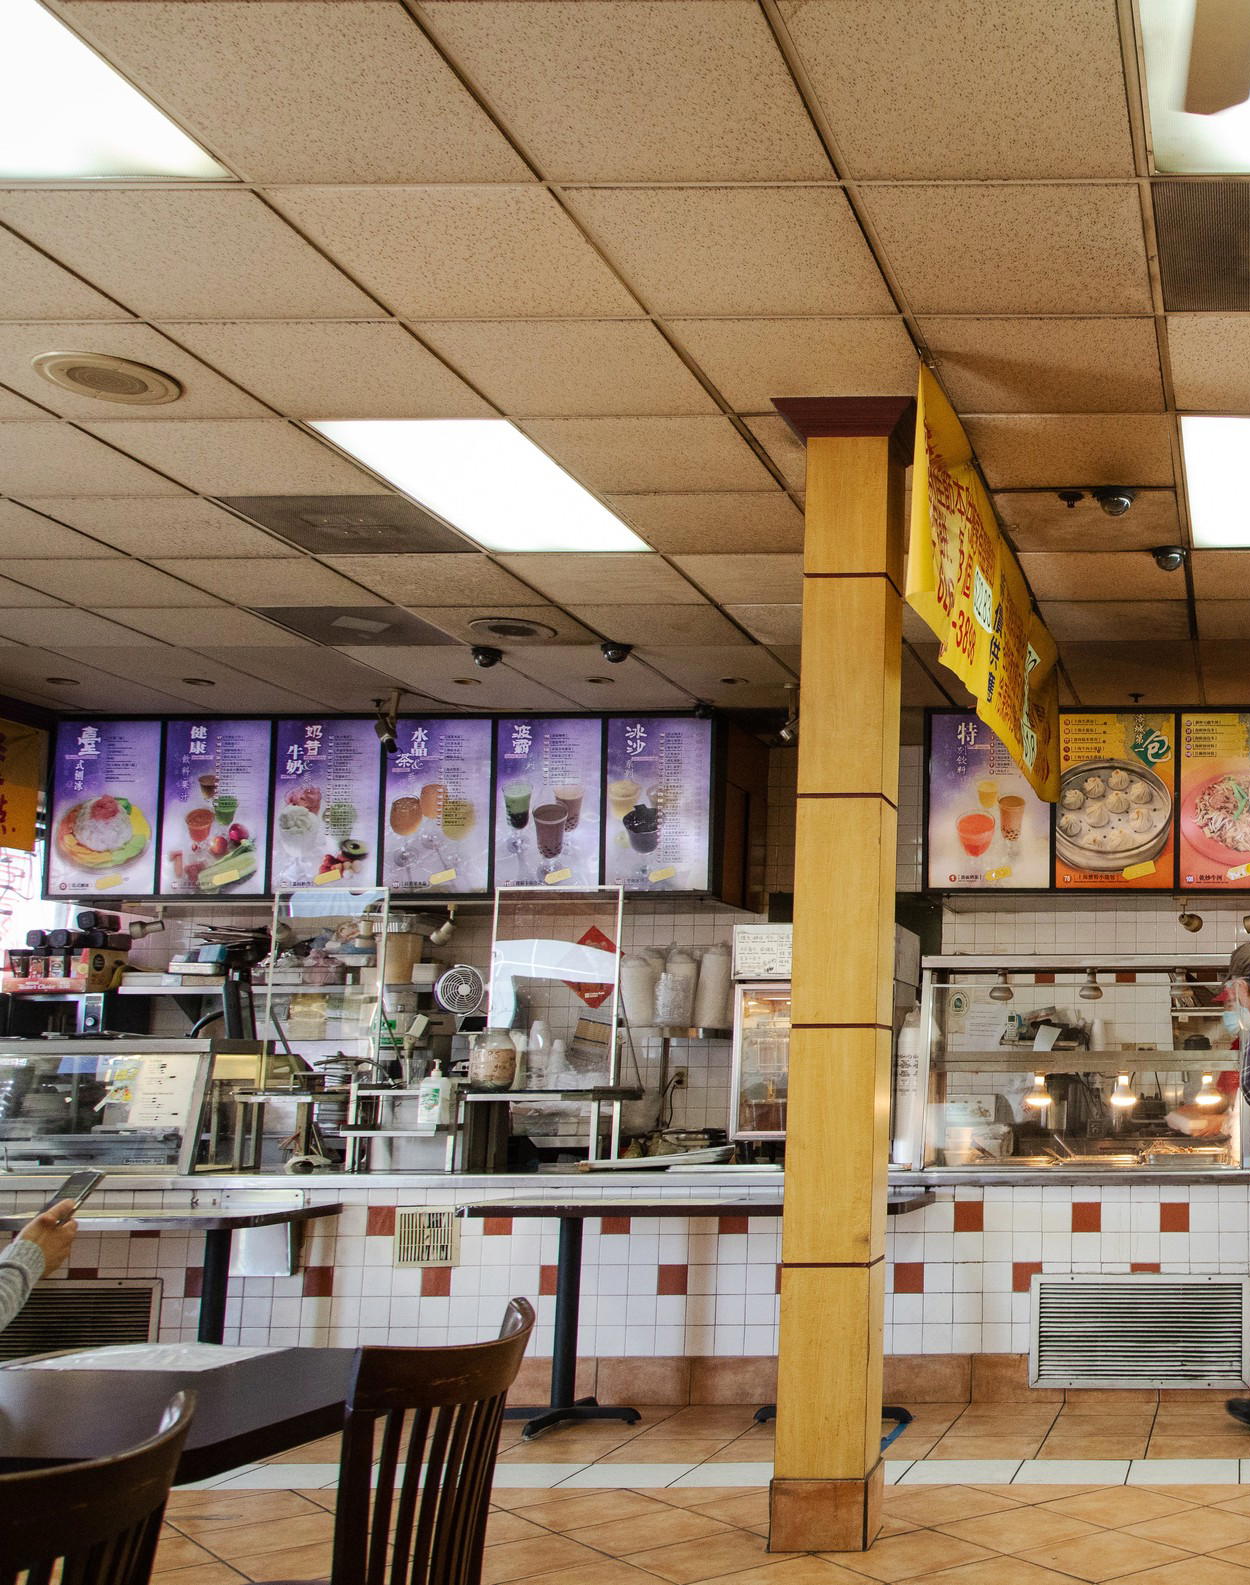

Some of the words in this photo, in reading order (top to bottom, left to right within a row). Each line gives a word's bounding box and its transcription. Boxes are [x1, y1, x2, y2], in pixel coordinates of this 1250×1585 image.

[189, 725, 208, 754] 健康
[304, 725, 324, 756] 奶昔
[410, 727, 429, 757] 水晶
[625, 723, 648, 756] 冰沙
[286, 744, 304, 775] 牛奶
[395, 753, 414, 768] 茶
